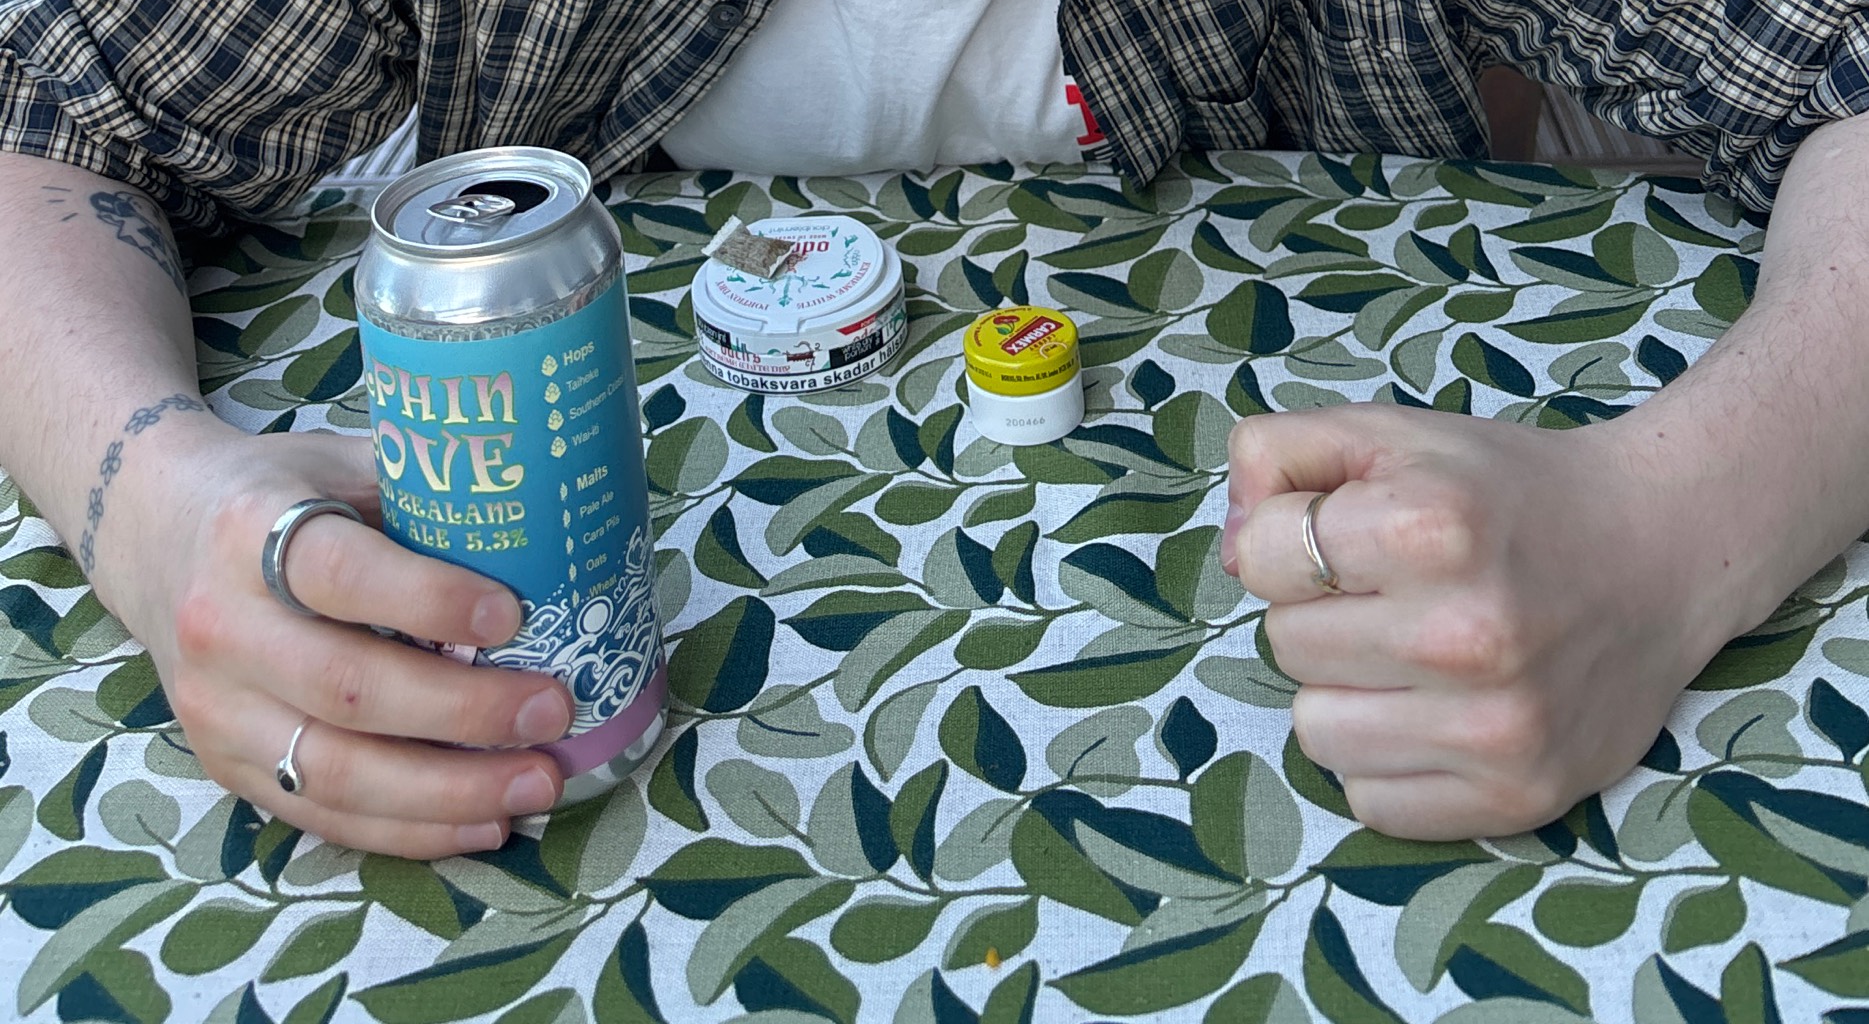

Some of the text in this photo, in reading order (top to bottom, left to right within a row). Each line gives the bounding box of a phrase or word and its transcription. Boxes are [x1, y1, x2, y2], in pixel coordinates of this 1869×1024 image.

[1006, 321, 1057, 354] CARMEX
[563, 341, 595, 366] Hops
[565, 368, 600, 392] Taiheke
[727, 371, 817, 392] tobaksvara
[823, 359, 876, 385] skadar
[367, 356, 519, 425] PHIN
[569, 391, 607, 419] Southern
[572, 423, 600, 446] Wai-iti
[1005, 416, 1046, 428] 200466
[576, 465, 609, 491] Malts
[397, 489, 526, 526] ZEALAND
[580, 490, 614, 518] Pale Ale
[407, 518, 451, 550] ALE
[465, 527, 529, 553] 5.3%
[583, 514, 621, 545] Cara Pils
[586, 552, 608, 571] Oats
[588, 573, 618, 597] Wheat
